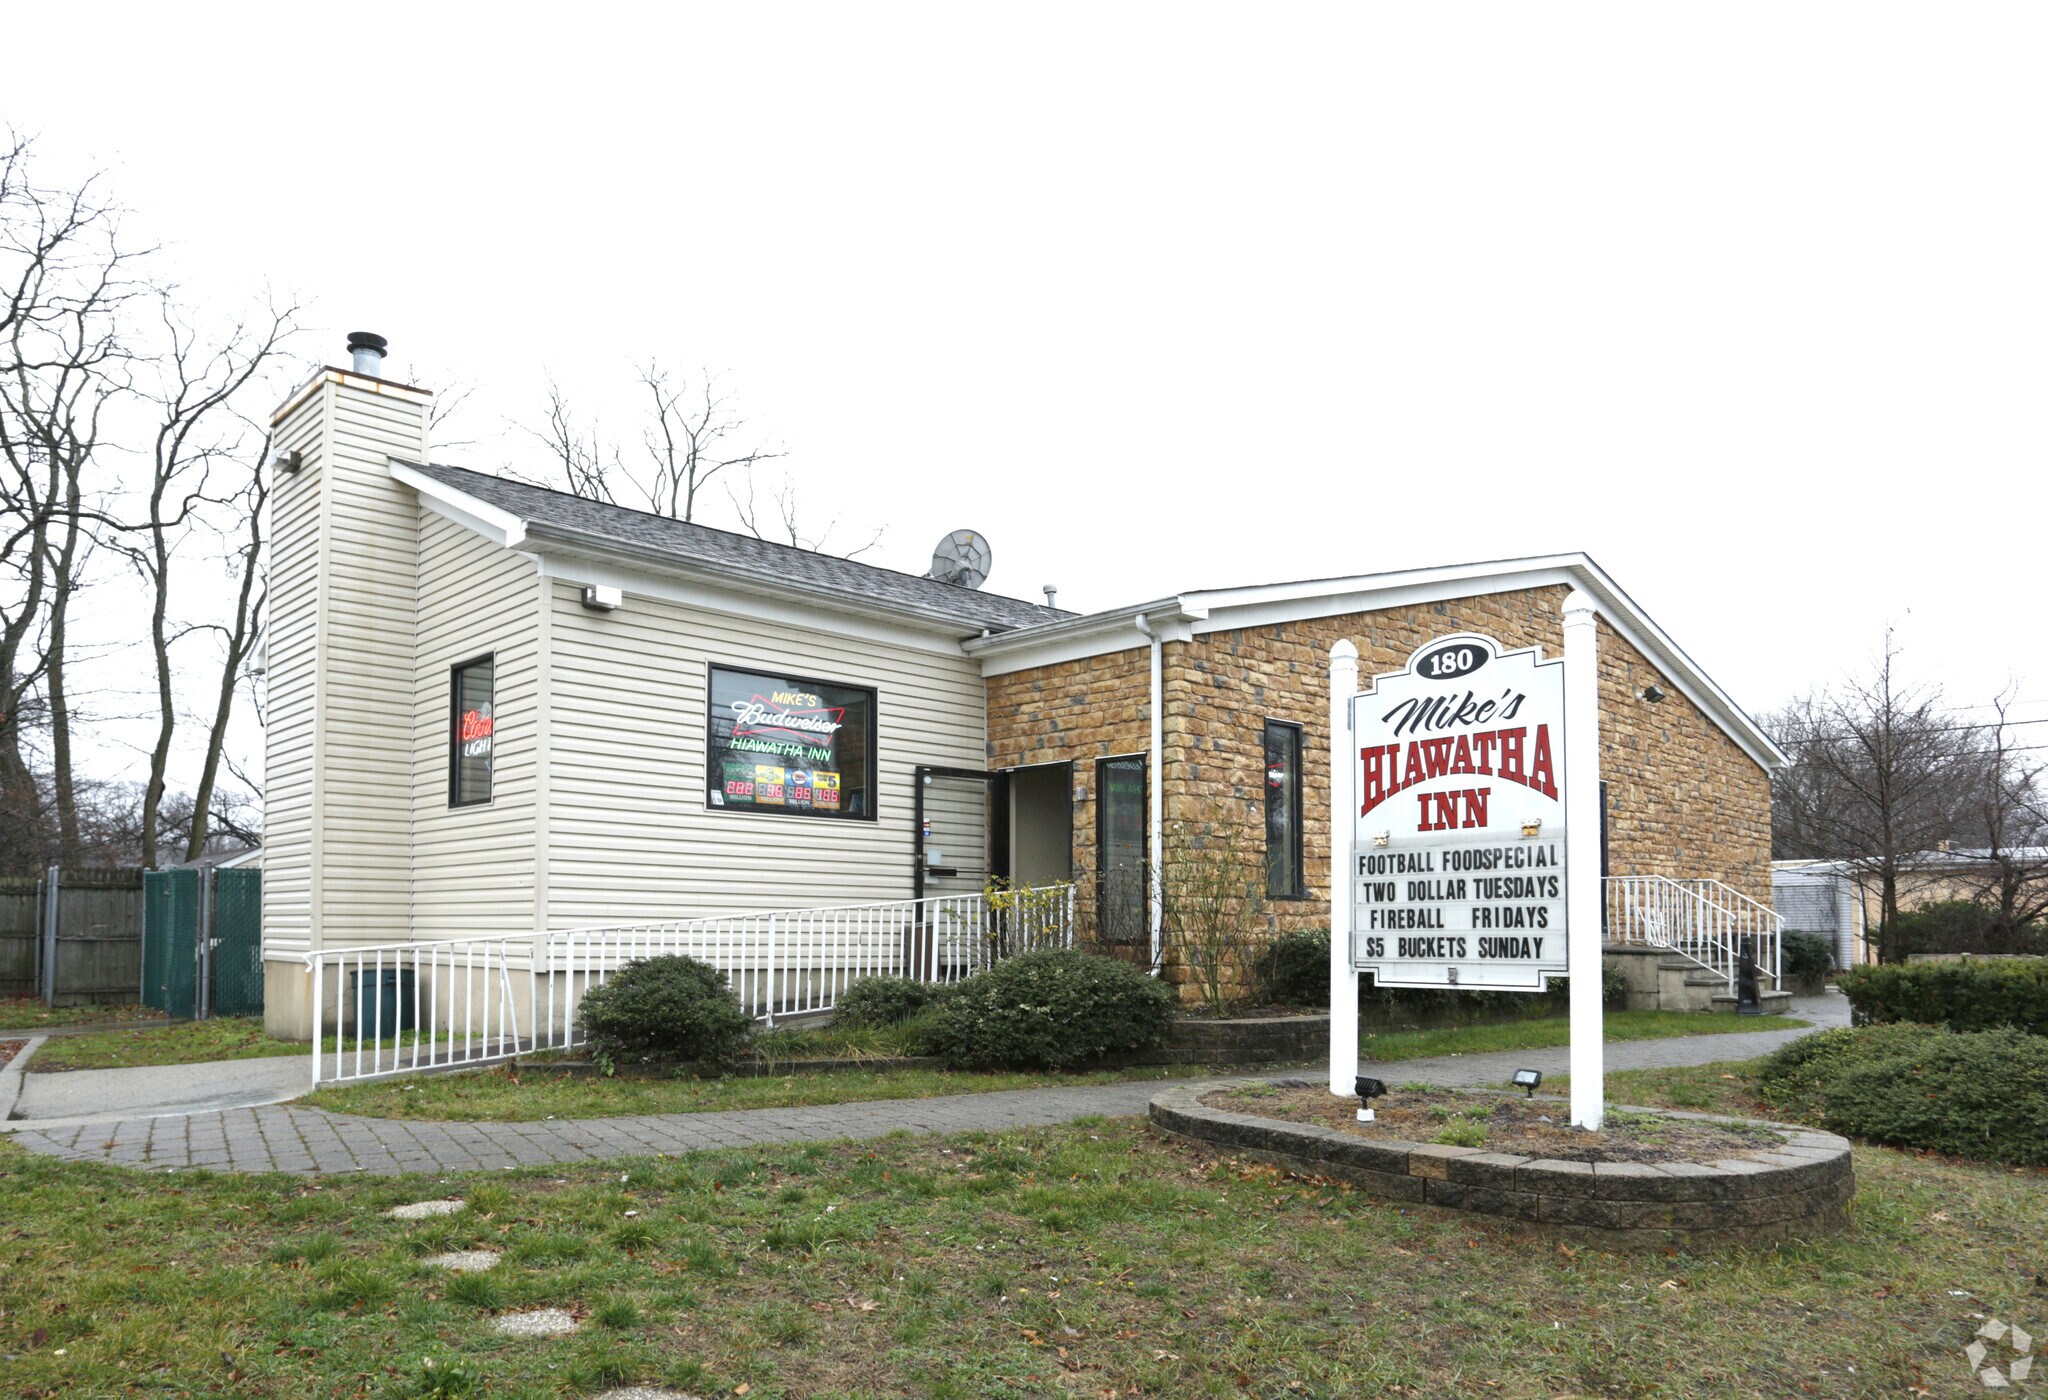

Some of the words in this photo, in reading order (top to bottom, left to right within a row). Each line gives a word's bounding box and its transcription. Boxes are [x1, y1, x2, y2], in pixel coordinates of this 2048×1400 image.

[1430, 648, 1474, 676] 180
[771, 691, 816, 707] MIKE'S
[1381, 688, 1526, 737] Mike's
[731, 701, 842, 733] Budweiser
[730, 737, 803, 757] HIAWATHA
[807, 747, 832, 761] INN
[1360, 723, 1559, 818] HIAWATHA
[1417, 787, 1491, 832] INN
[1359, 852, 1434, 875] FOOTBALL
[1363, 881, 1396, 903] TWO
[1407, 878, 1466, 901] DOLLAR
[1473, 875, 1559, 899] TUESDAYS
[1370, 908, 1444, 929] FIREBALL
[1472, 906, 1548, 929] FRIDAYS
[1398, 936, 1467, 958] BUCKETS
[1478, 936, 1543, 959] SUNDAY
